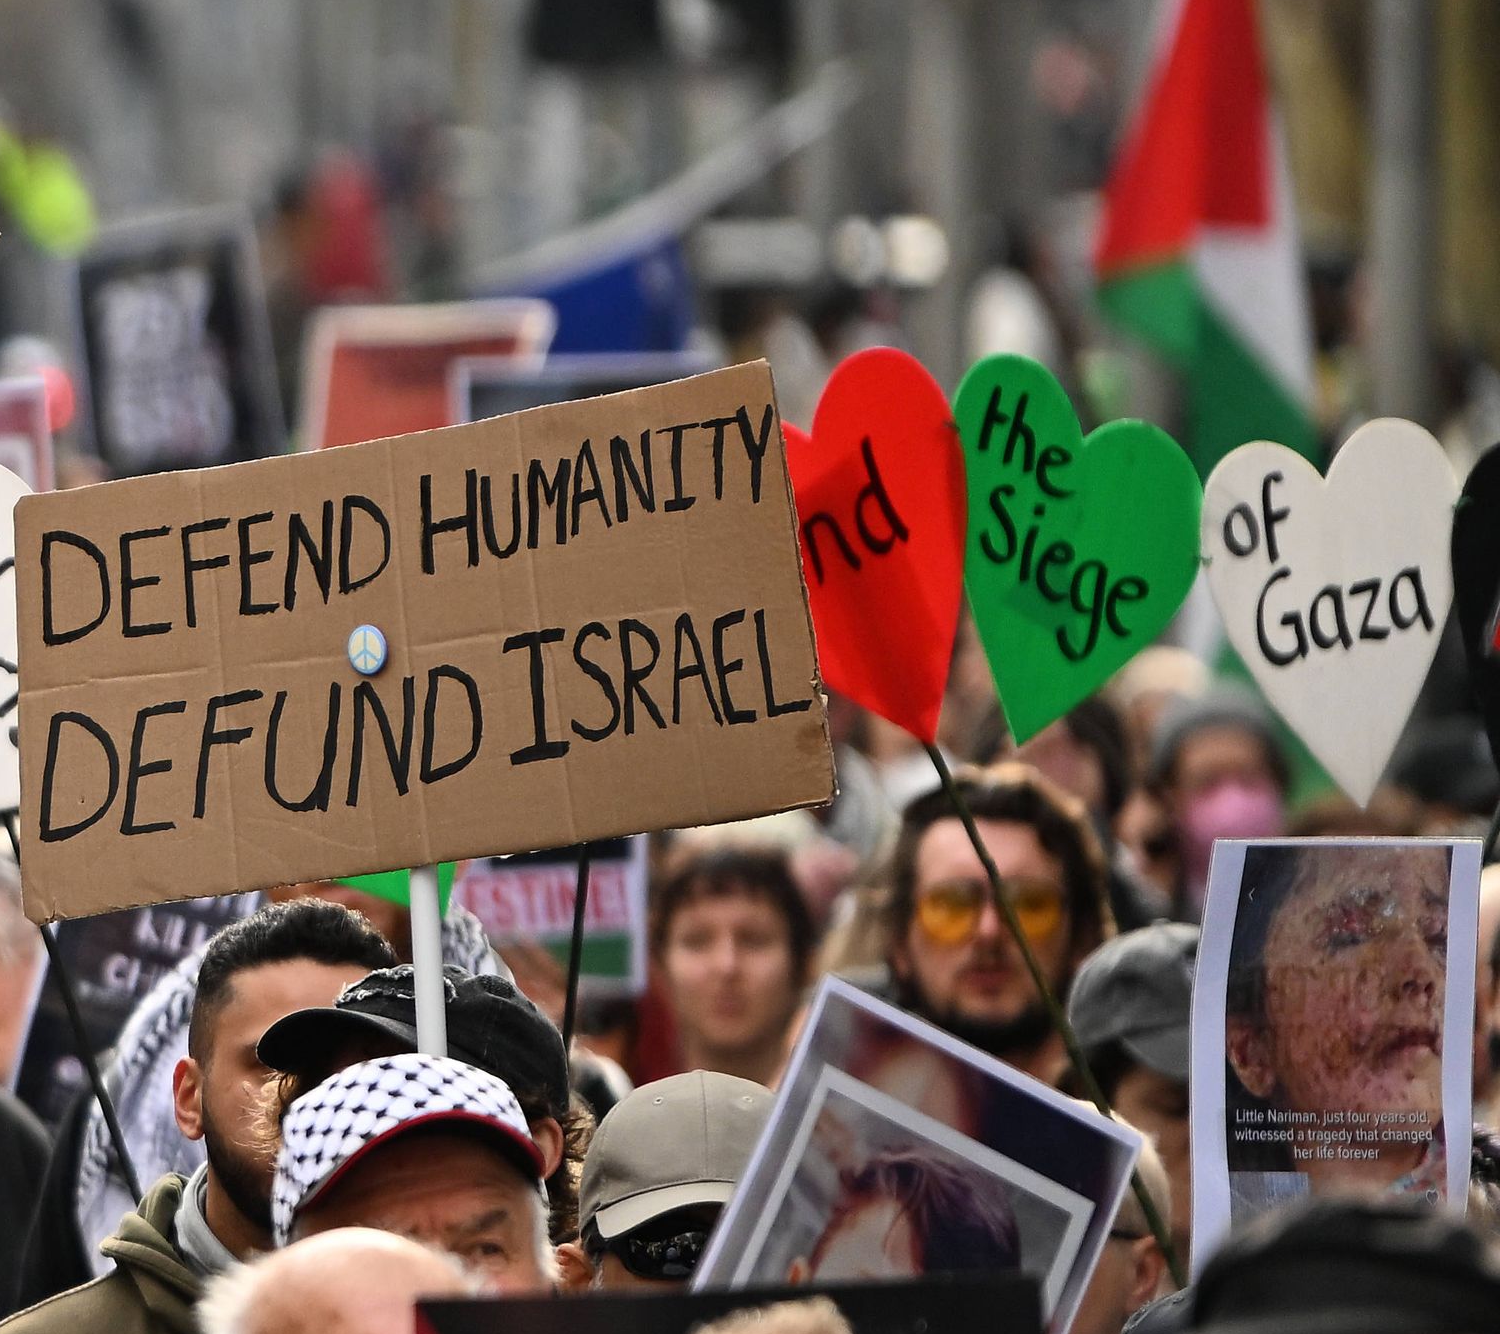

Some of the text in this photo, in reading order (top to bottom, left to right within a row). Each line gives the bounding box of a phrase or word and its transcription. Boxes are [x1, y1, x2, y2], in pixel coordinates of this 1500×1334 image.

[978, 386, 1075, 498] the
[41, 404, 774, 646] DEFEND HUMANITY
[804, 436, 908, 584] nd
[1222, 471, 1290, 563] of
[980, 484, 1149, 662] Siege
[1256, 566, 1434, 666] Gaza
[40, 608, 811, 843] DEFUND ISRAEL
[1235, 1128, 1433, 1144] witnessed a tragedy that changed
[1236, 1109, 1430, 1126] Little Nariman, just four years old,
[1294, 1146, 1380, 1159] her life forever
